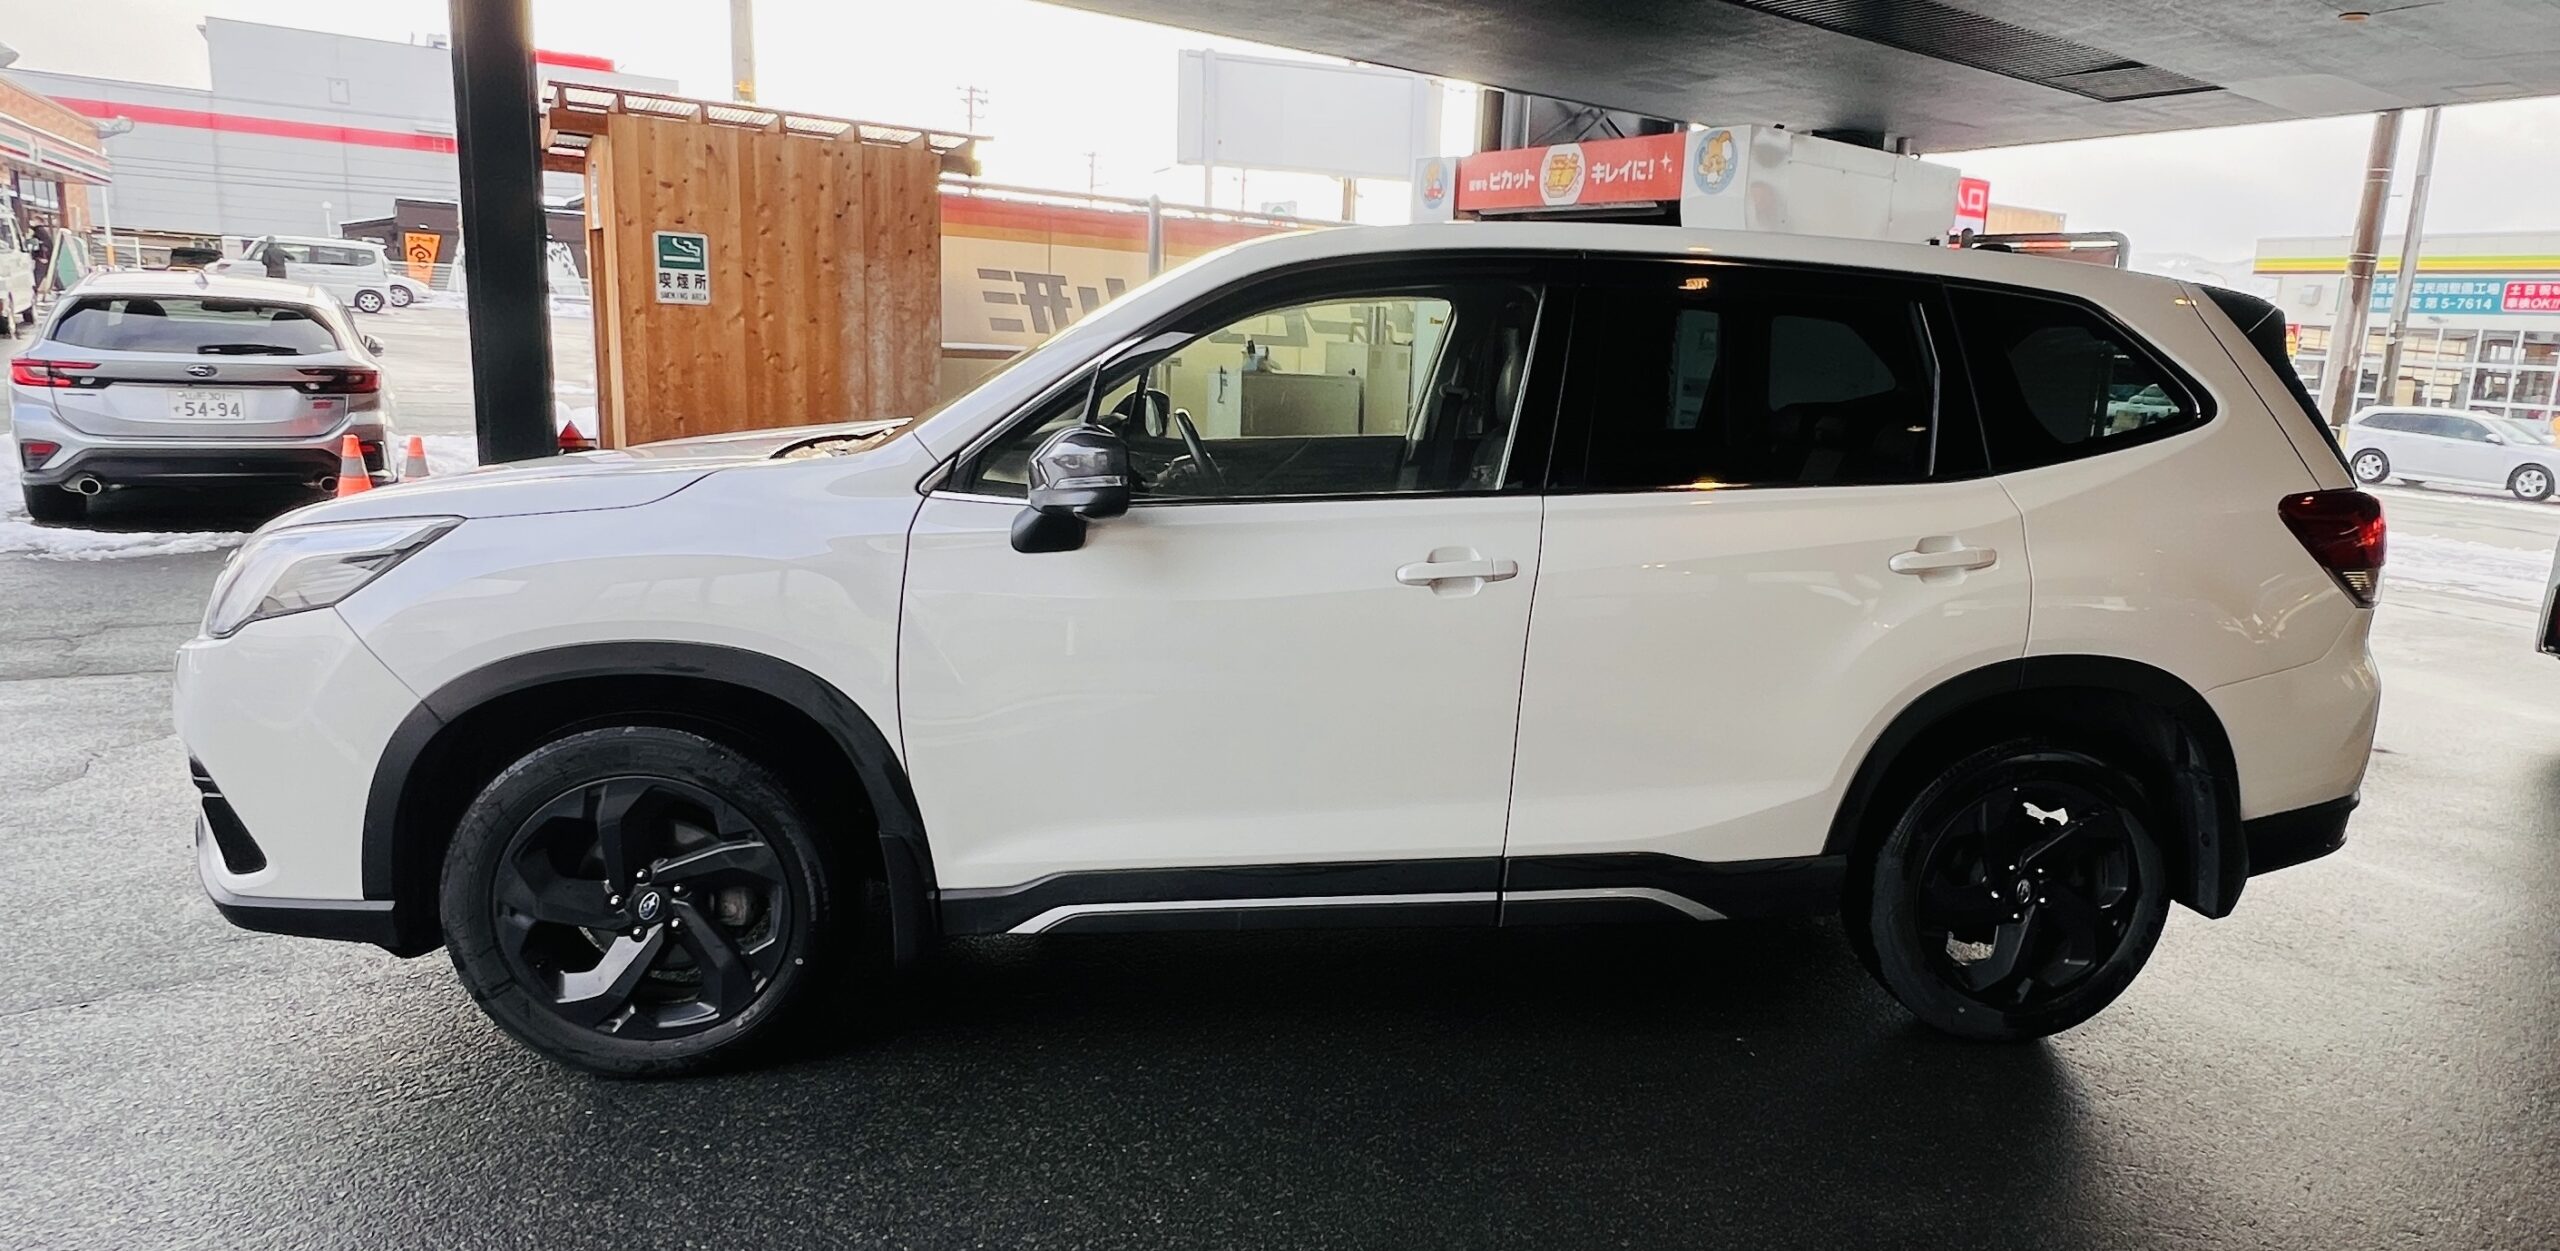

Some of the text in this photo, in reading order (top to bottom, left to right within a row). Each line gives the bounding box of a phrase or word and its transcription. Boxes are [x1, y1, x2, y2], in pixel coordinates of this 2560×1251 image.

[1591, 158, 1655, 184] キレイに!
[2440, 297, 2493, 311] 5-7614
[185, 402, 241, 417] 54-94
